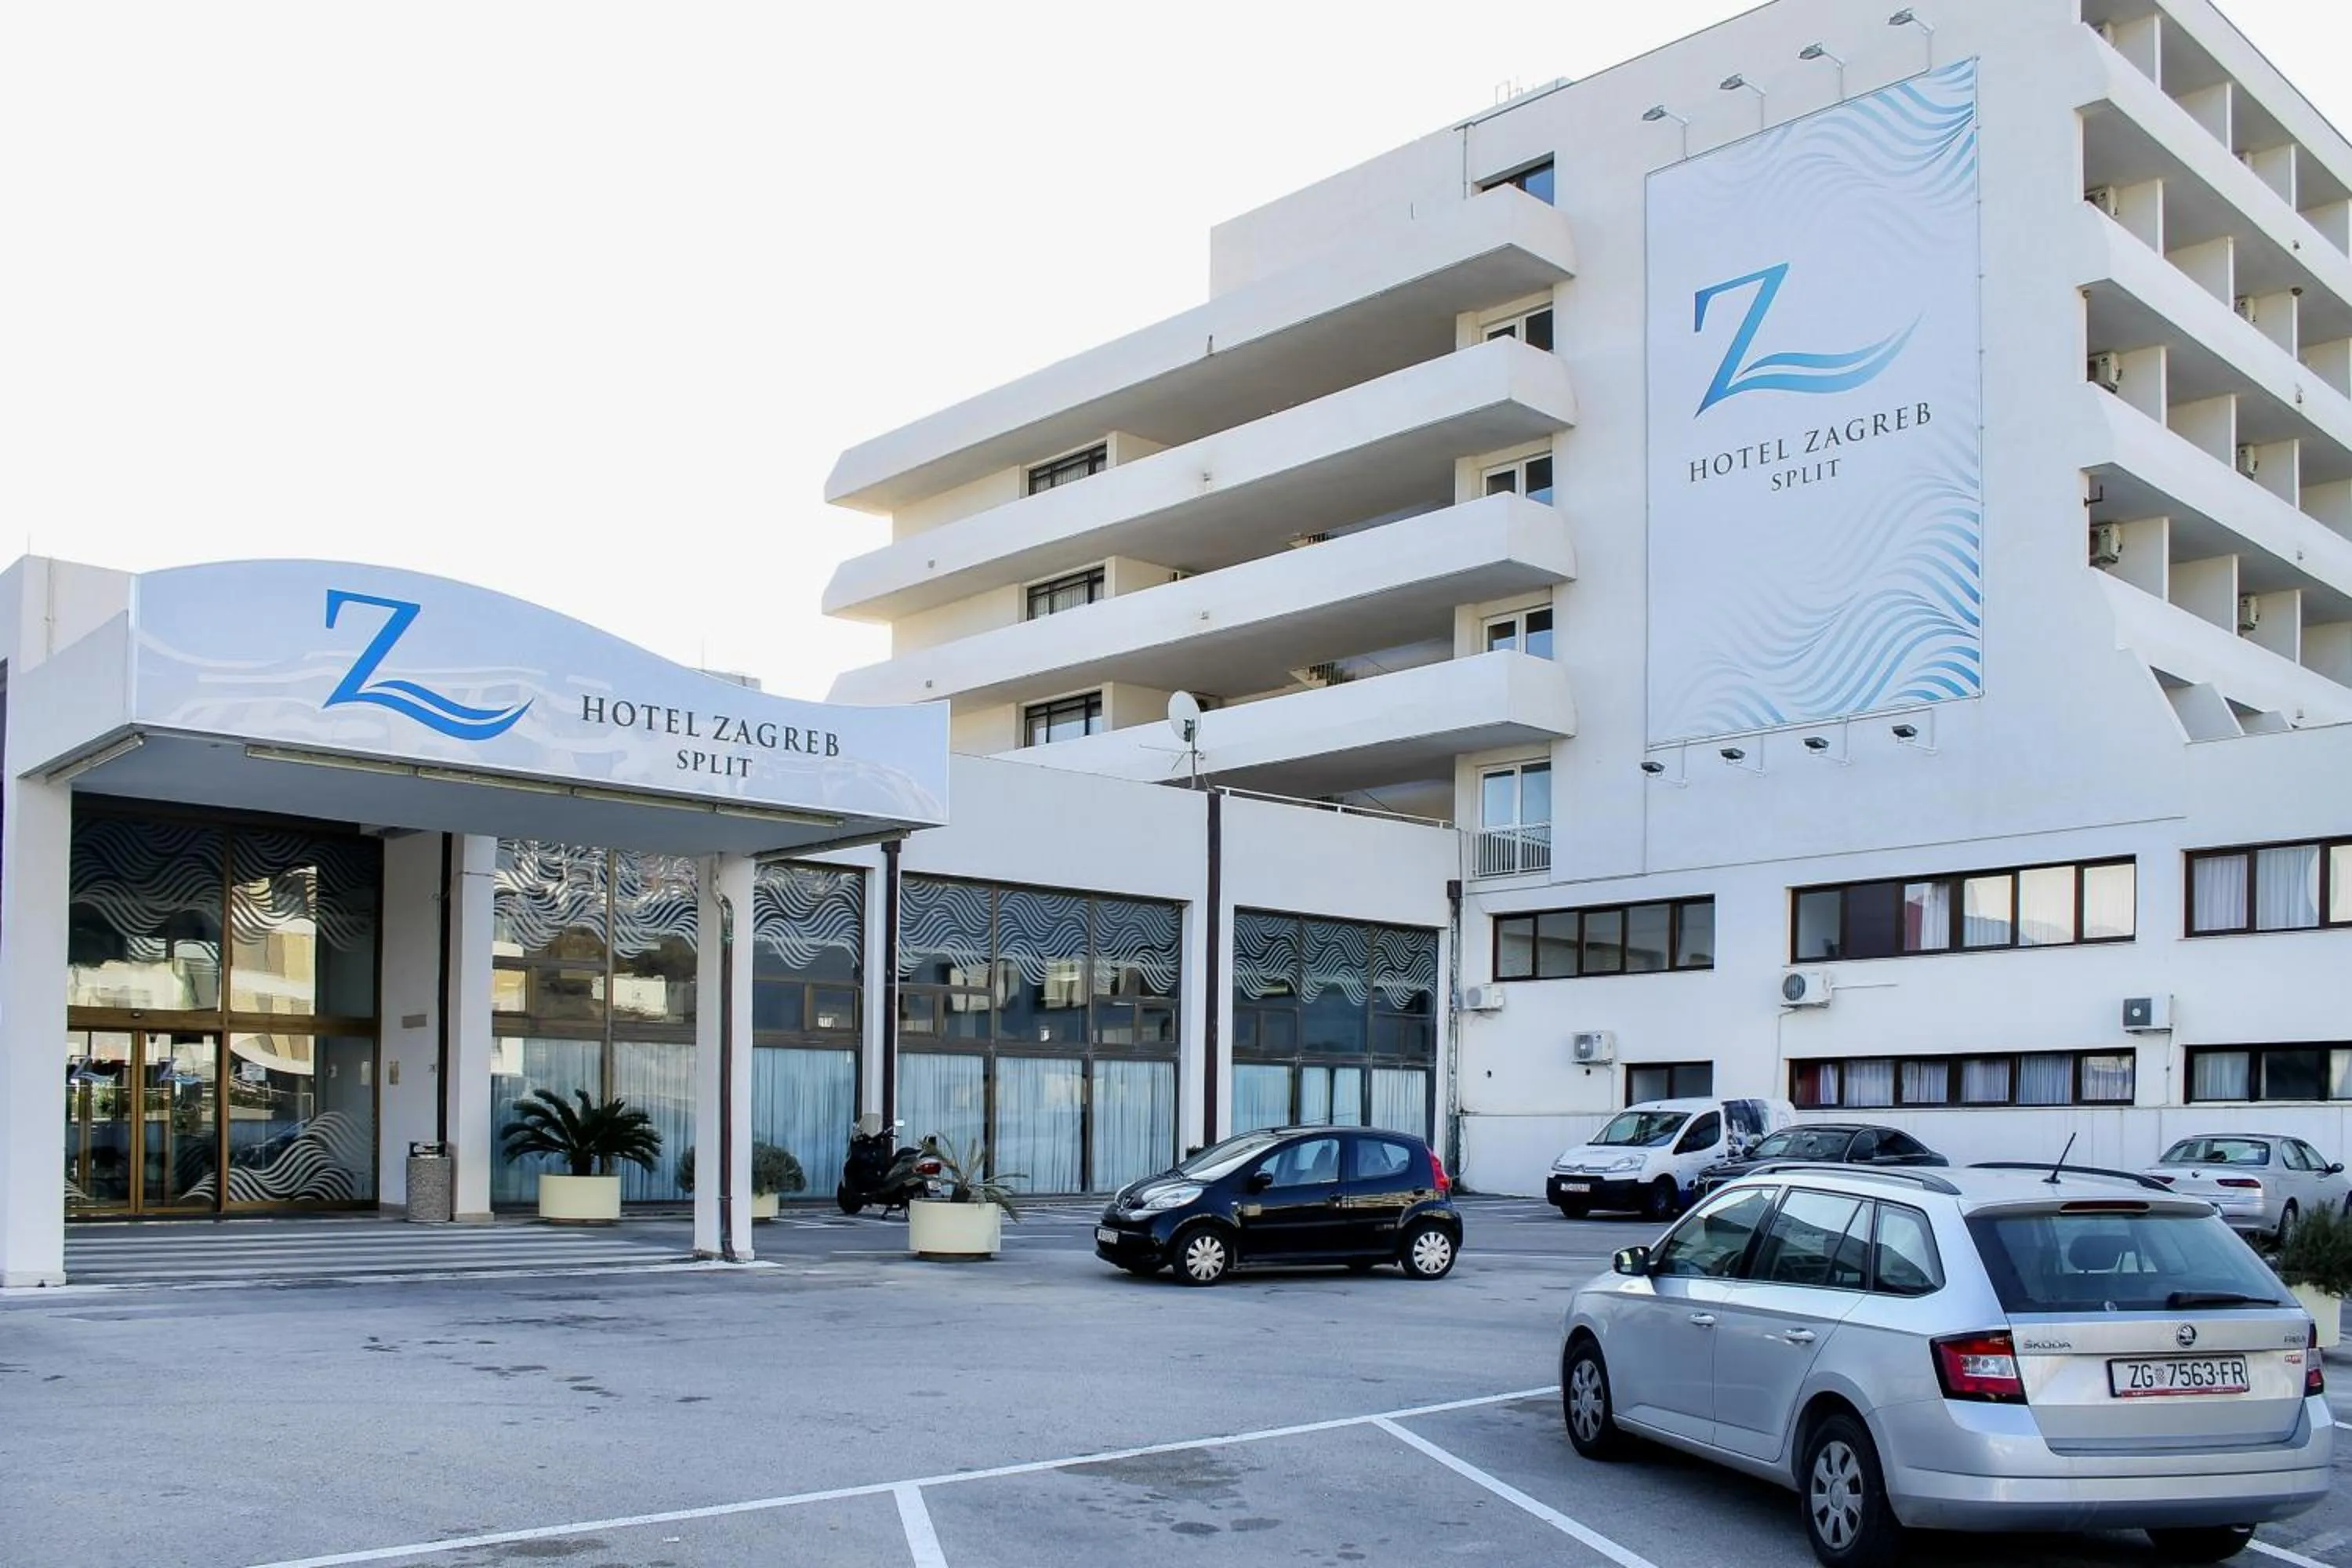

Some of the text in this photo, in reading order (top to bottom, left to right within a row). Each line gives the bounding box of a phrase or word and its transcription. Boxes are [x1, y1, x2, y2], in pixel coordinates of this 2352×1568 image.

[1689, 401, 1932, 483] HOTEL ZAGREB
[1770, 458, 1842, 492] SPLIT
[582, 695, 840, 757] HOTEL ZAGREB
[677, 749, 753, 778] SPLIT
[2127, 1363, 2154, 1389] ZG
